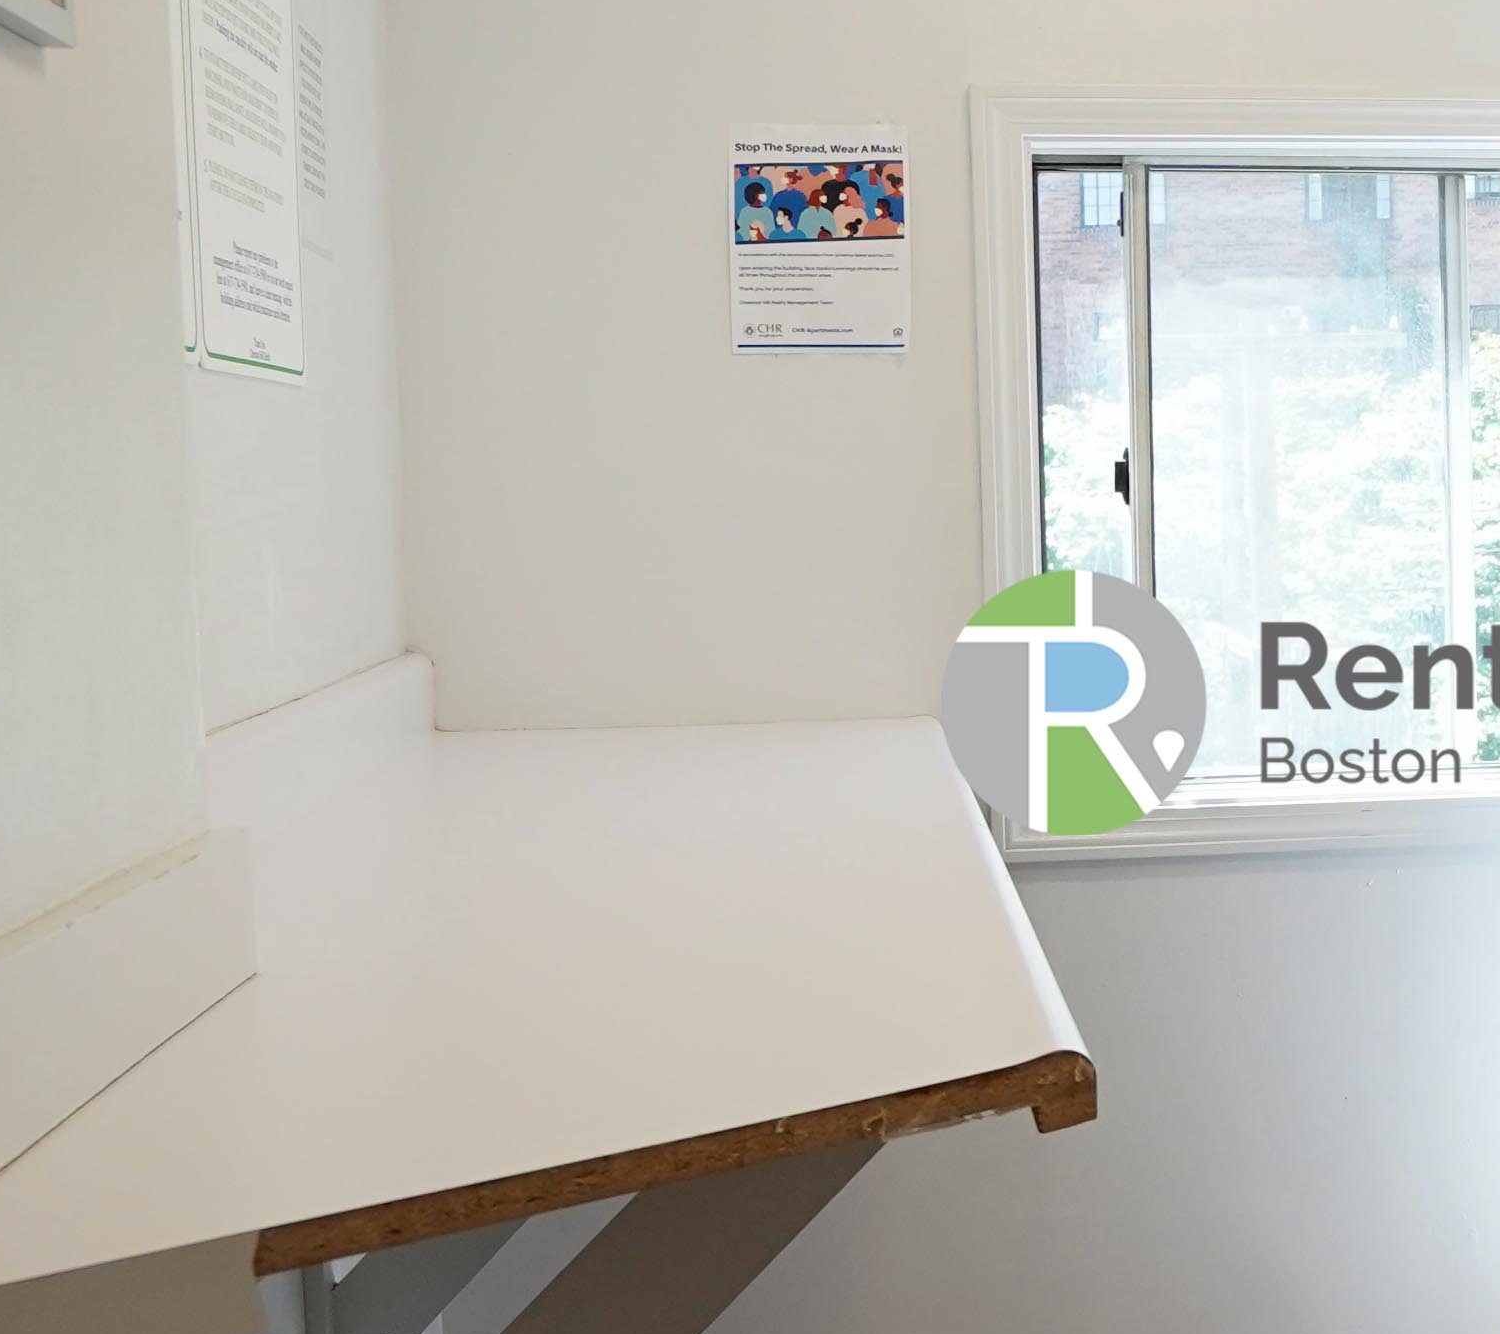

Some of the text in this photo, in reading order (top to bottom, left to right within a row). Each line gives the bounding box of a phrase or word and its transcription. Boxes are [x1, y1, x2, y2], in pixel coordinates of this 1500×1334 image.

[734, 143, 902, 154] Stop The Spread, Wear A Mask!
[757, 323, 783, 334] CHR
